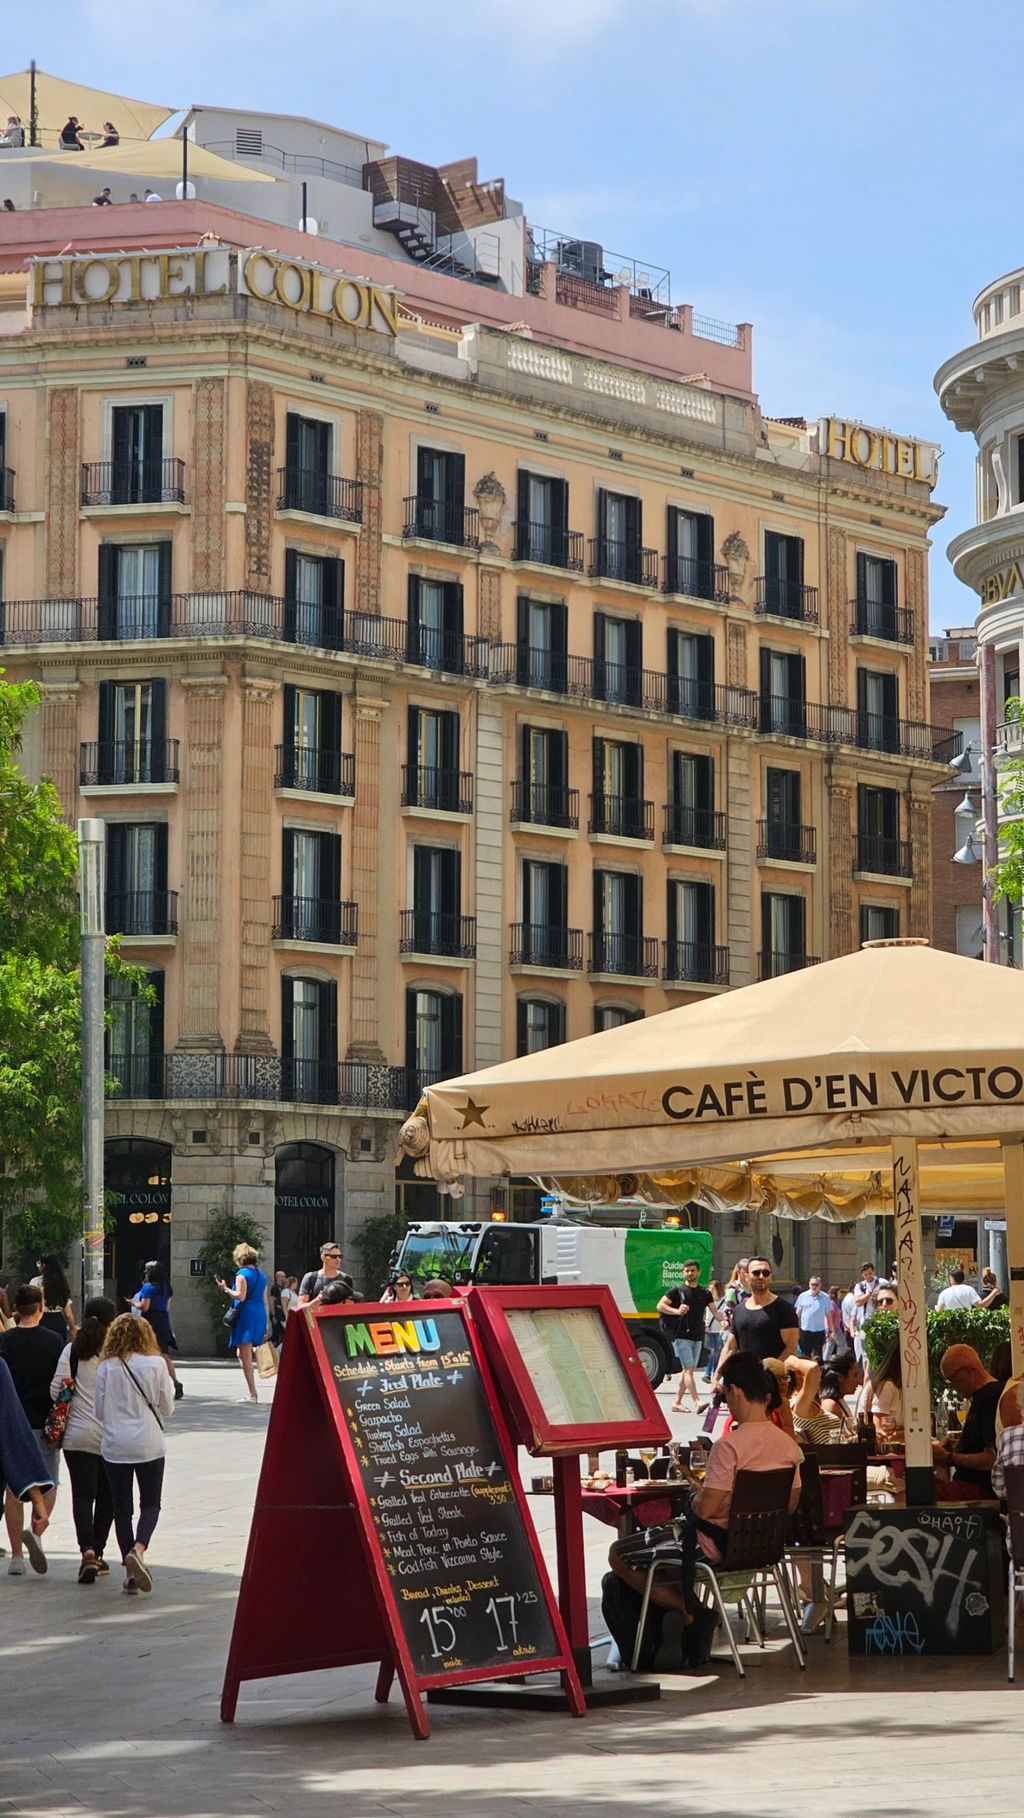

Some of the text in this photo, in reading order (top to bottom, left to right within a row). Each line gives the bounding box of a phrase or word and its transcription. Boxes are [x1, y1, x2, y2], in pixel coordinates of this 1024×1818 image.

[32, 251, 400, 338] HOTEL COLON
[827, 419, 934, 485] HOTEL
[661, 1070, 768, 1120] CAFÈ
[890, 1065, 1024, 1104] VICTO
[344, 1318, 441, 1359] MENU
[409, 1371, 444, 1389] Plate
[383, 1395, 412, 1410] Salad
[359, 1411, 403, 1427] Gazpacho
[363, 1421, 423, 1442] Turkey Salad
[368, 1439, 405, 1453] Shellfish
[370, 1454, 398, 1467] Fried
[399, 1450, 420, 1465] Eggs
[440, 1445, 480, 1458] Sausage
[399, 1460, 485, 1487] Second Plate
[377, 1495, 408, 1510] Grilled
[381, 1512, 413, 1527] Grilled
[437, 1504, 466, 1520] Steak
[386, 1524, 450, 1544] Fish of Today
[392, 1545, 417, 1559] Meat
[442, 1542, 452, 1553] in
[451, 1534, 478, 1550] Porto
[480, 1531, 508, 1545] Sauce
[397, 1546, 504, 1575] Codfish Vizcaina Style
[465, 1575, 500, 1592] Dessert
